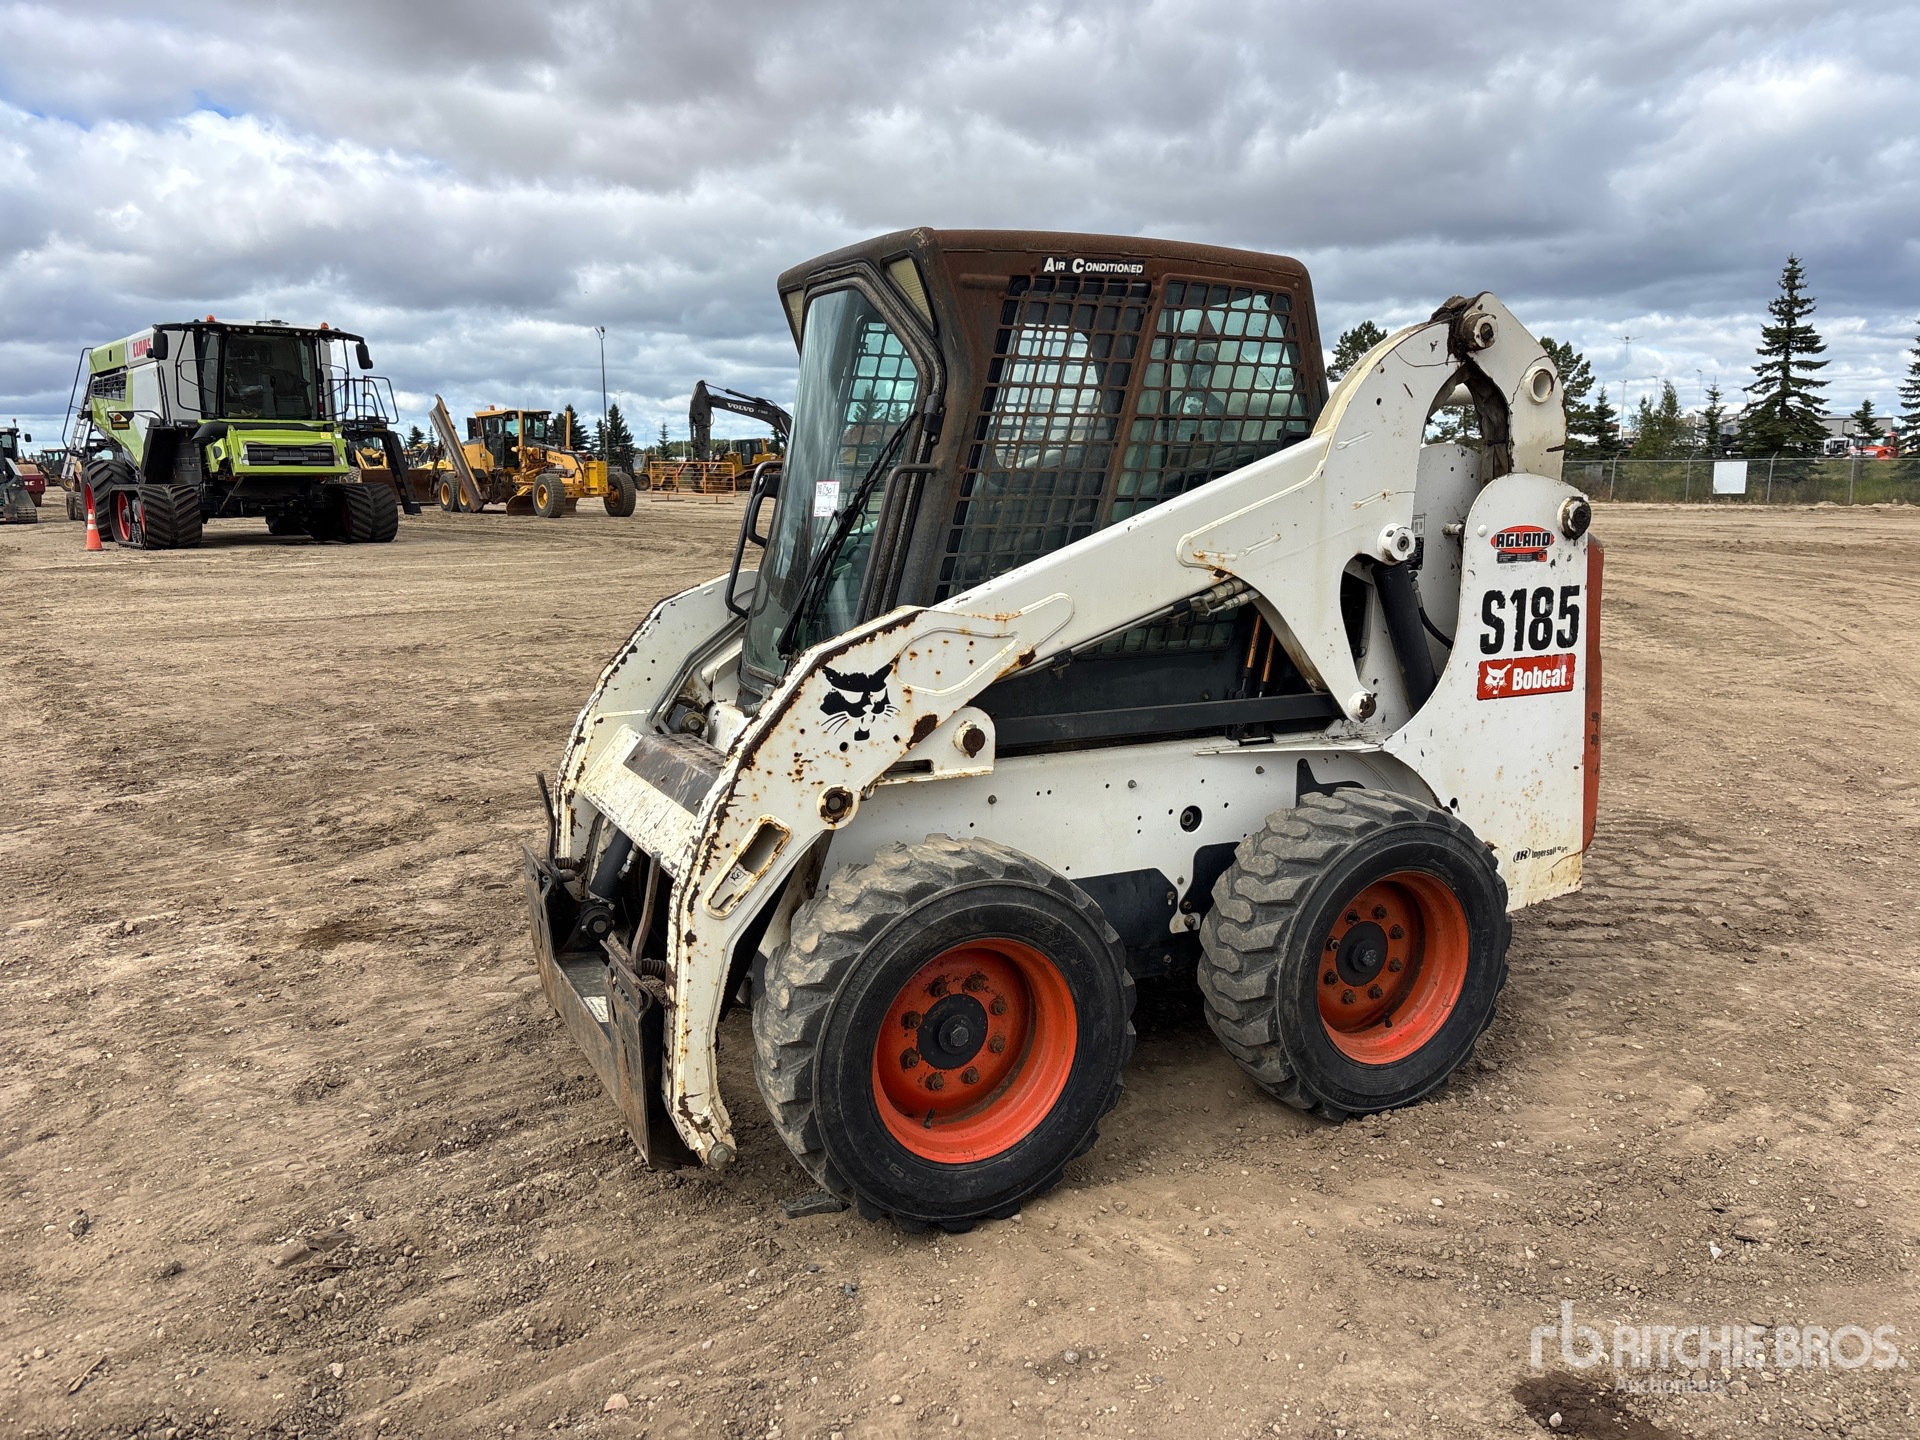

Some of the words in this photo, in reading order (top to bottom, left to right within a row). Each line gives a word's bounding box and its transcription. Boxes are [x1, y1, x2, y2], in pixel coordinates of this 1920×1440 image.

[726, 402, 755, 413] VOLVO
[1495, 532, 1551, 548] AGLAND
[1480, 585, 1580, 655] S185
[1512, 664, 1568, 691] Bobcat
